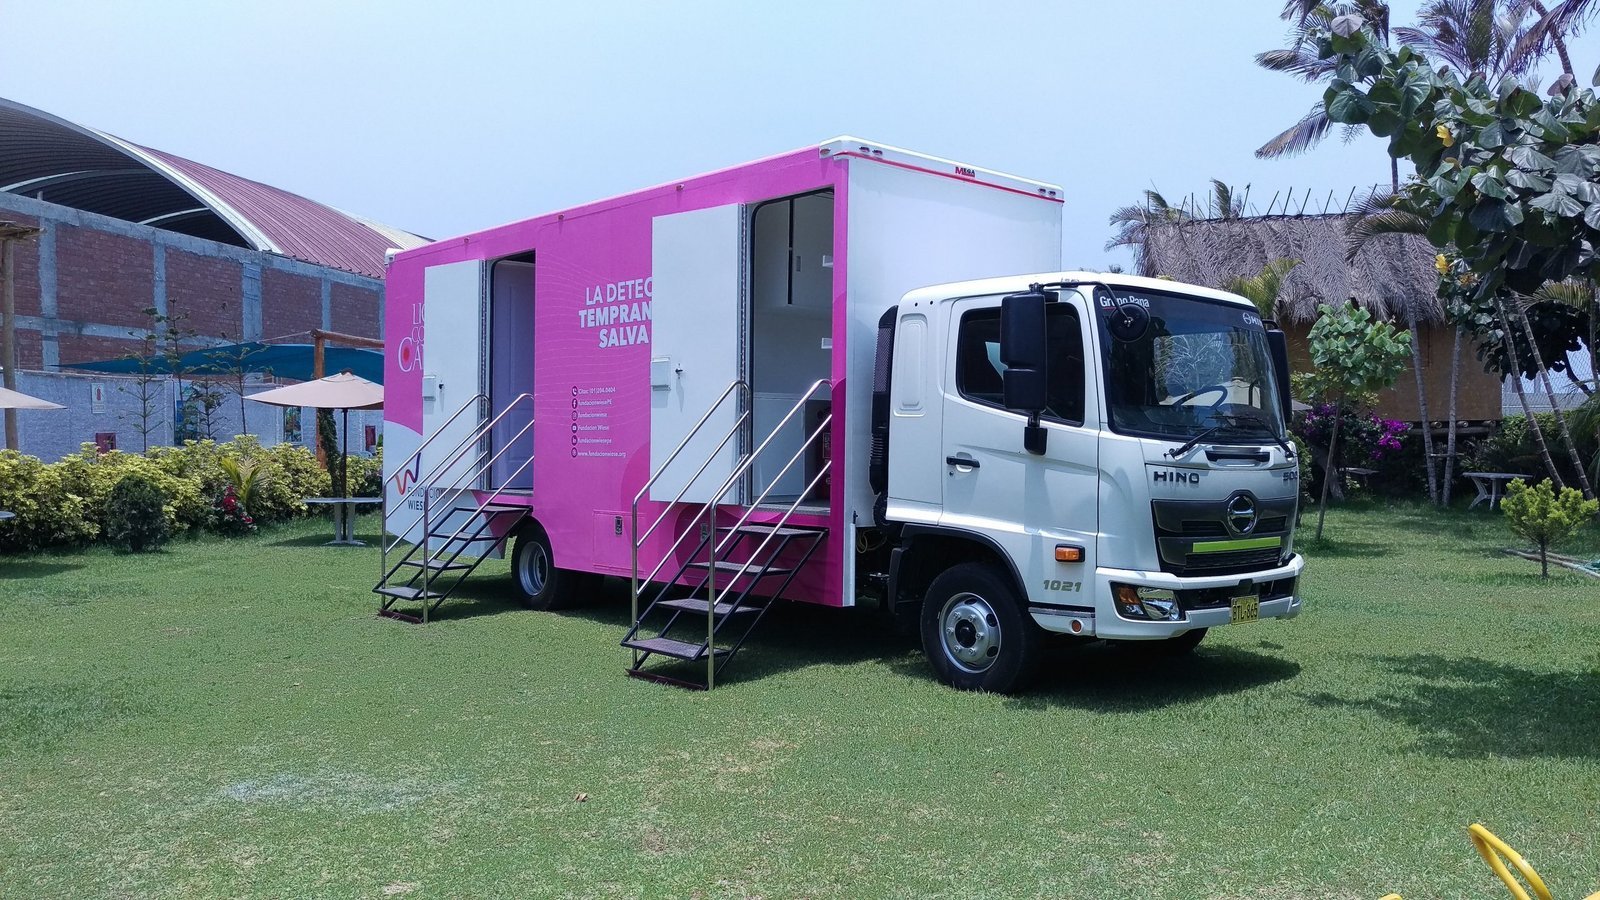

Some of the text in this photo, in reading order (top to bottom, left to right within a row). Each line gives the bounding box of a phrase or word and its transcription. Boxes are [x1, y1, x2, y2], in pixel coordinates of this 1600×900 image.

[585, 285, 603, 306] LA
[1100, 295, 1128, 308] Grpo
[598, 325, 649, 348] SALVA
[1153, 470, 1200, 485] HINO
[1043, 579, 1082, 593] 1021
